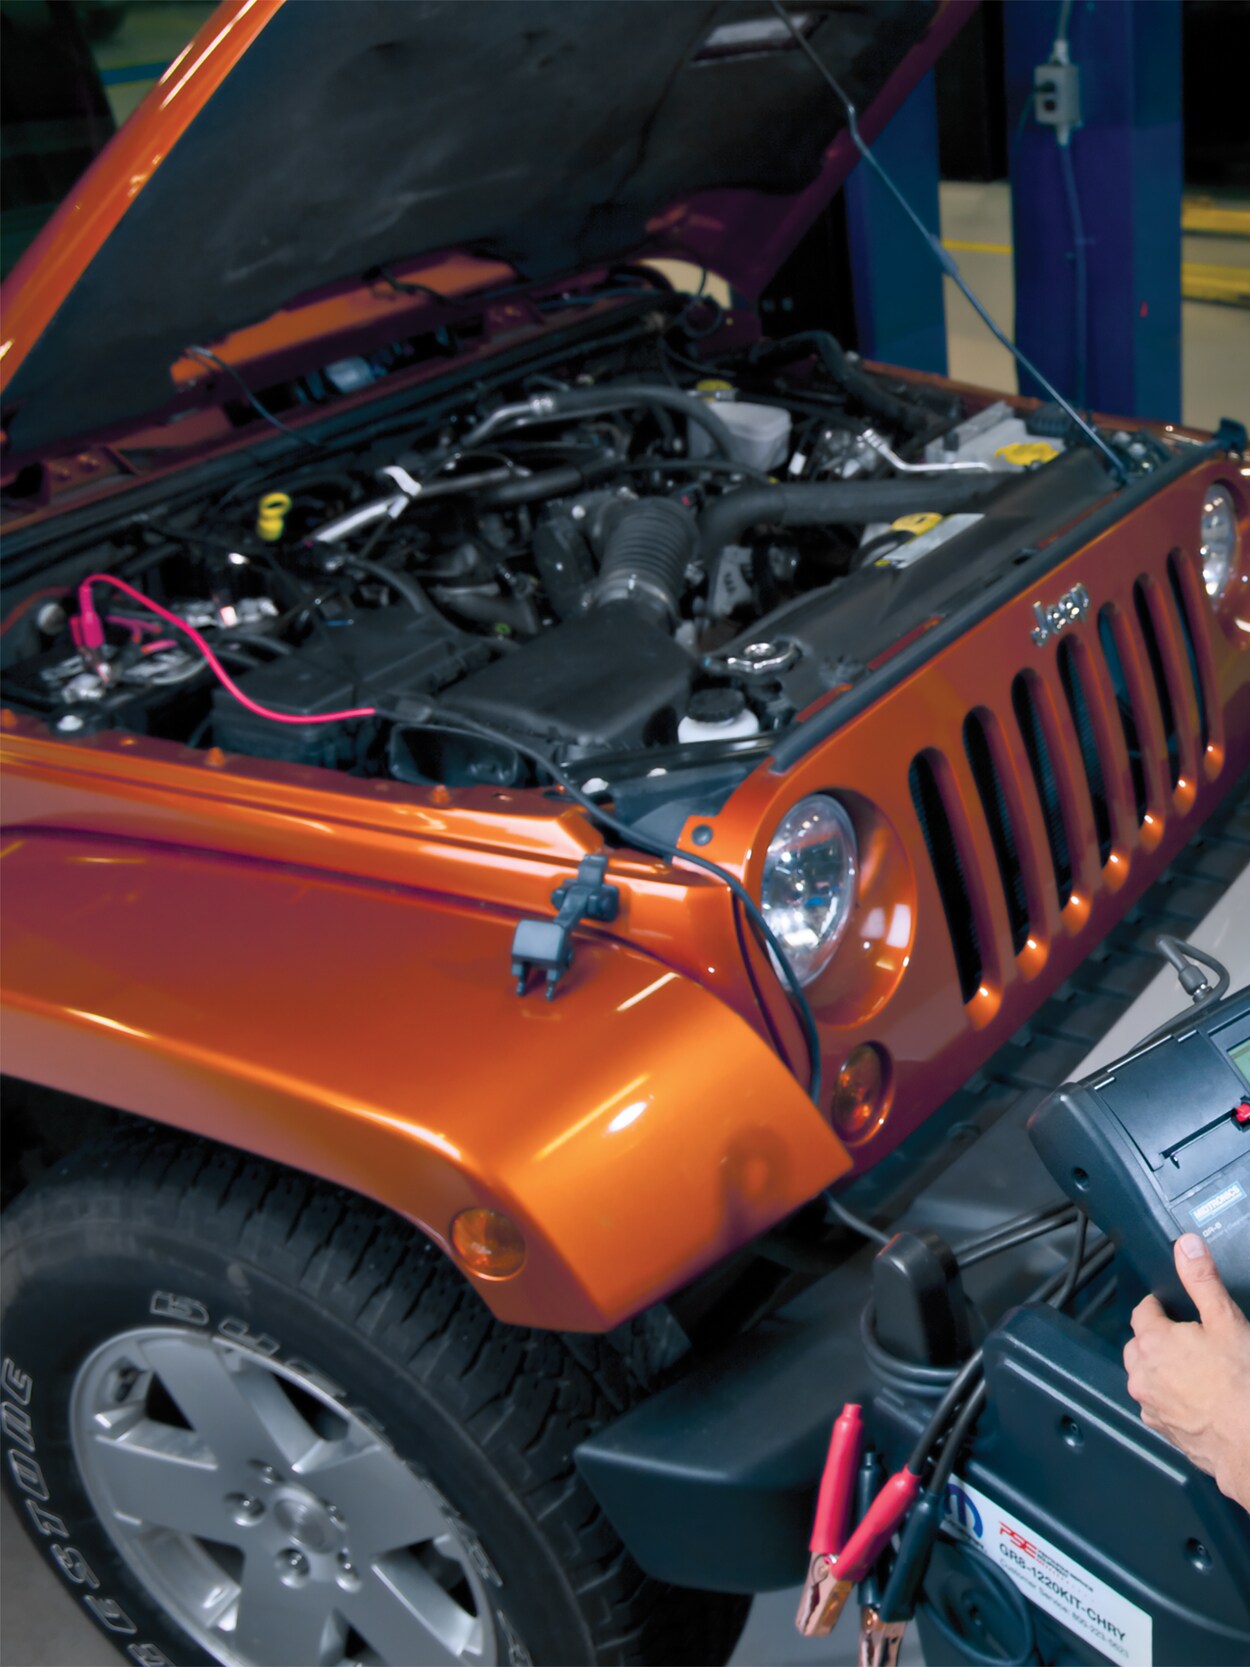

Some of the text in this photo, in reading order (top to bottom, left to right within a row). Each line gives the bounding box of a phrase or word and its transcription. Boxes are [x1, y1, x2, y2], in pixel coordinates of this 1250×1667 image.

[1030, 582, 1089, 647] Jeep
[999, 1521, 1037, 1559] PSE
[1000, 1543, 1126, 1641] GR8-1220KIT-CHRY
